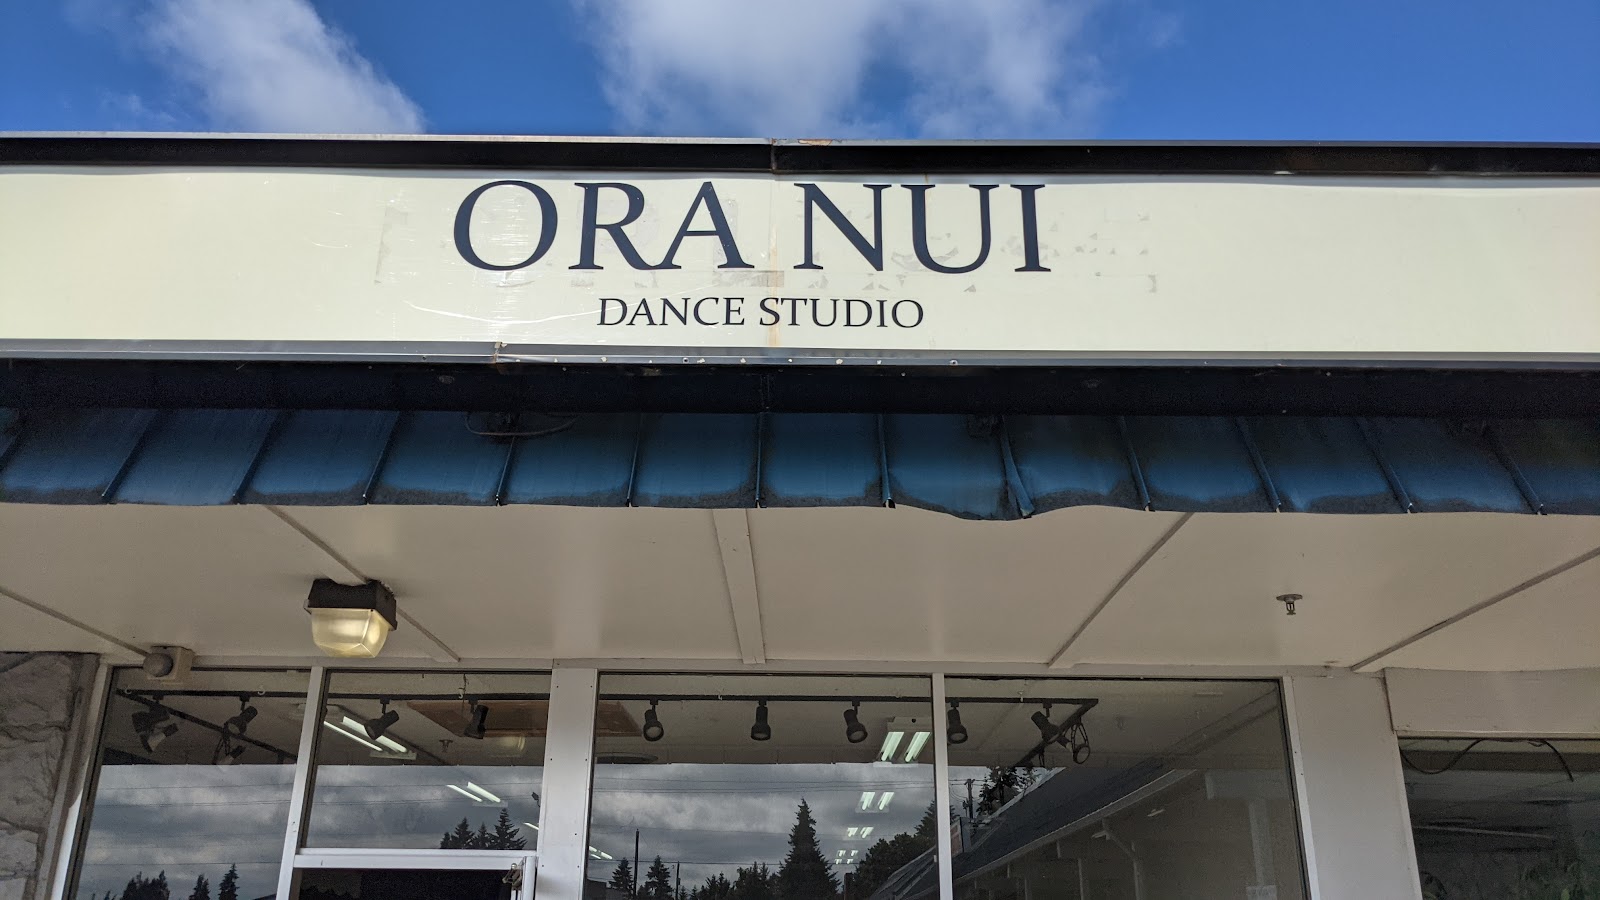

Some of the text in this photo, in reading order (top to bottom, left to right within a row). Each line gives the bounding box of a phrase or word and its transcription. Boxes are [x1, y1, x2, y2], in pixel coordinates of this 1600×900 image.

[453, 179, 1052, 274] ORA NUI
[597, 298, 924, 328] DANCE STUDIO
